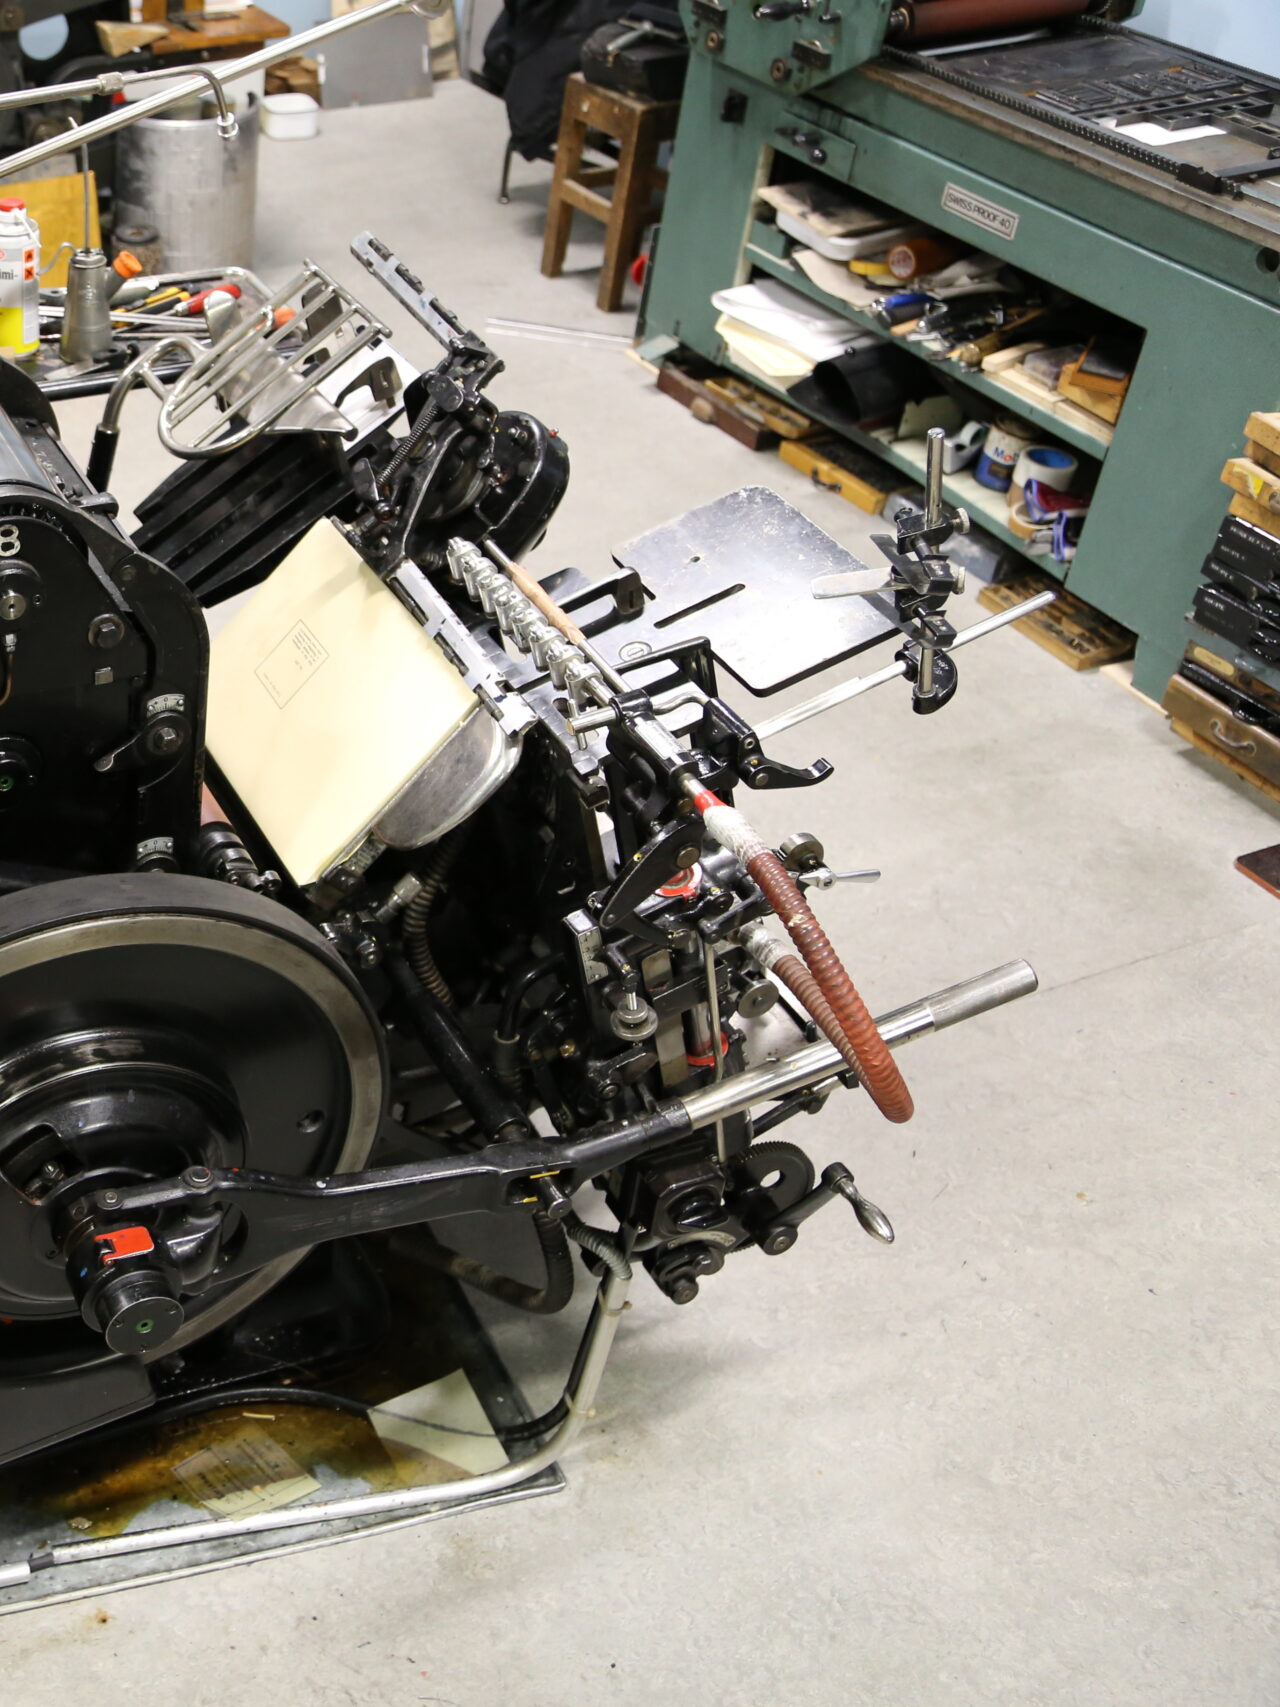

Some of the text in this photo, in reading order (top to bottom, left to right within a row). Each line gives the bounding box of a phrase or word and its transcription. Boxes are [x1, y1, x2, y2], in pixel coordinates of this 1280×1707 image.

[947, 193, 1012, 230] SWISS PROOF 40
